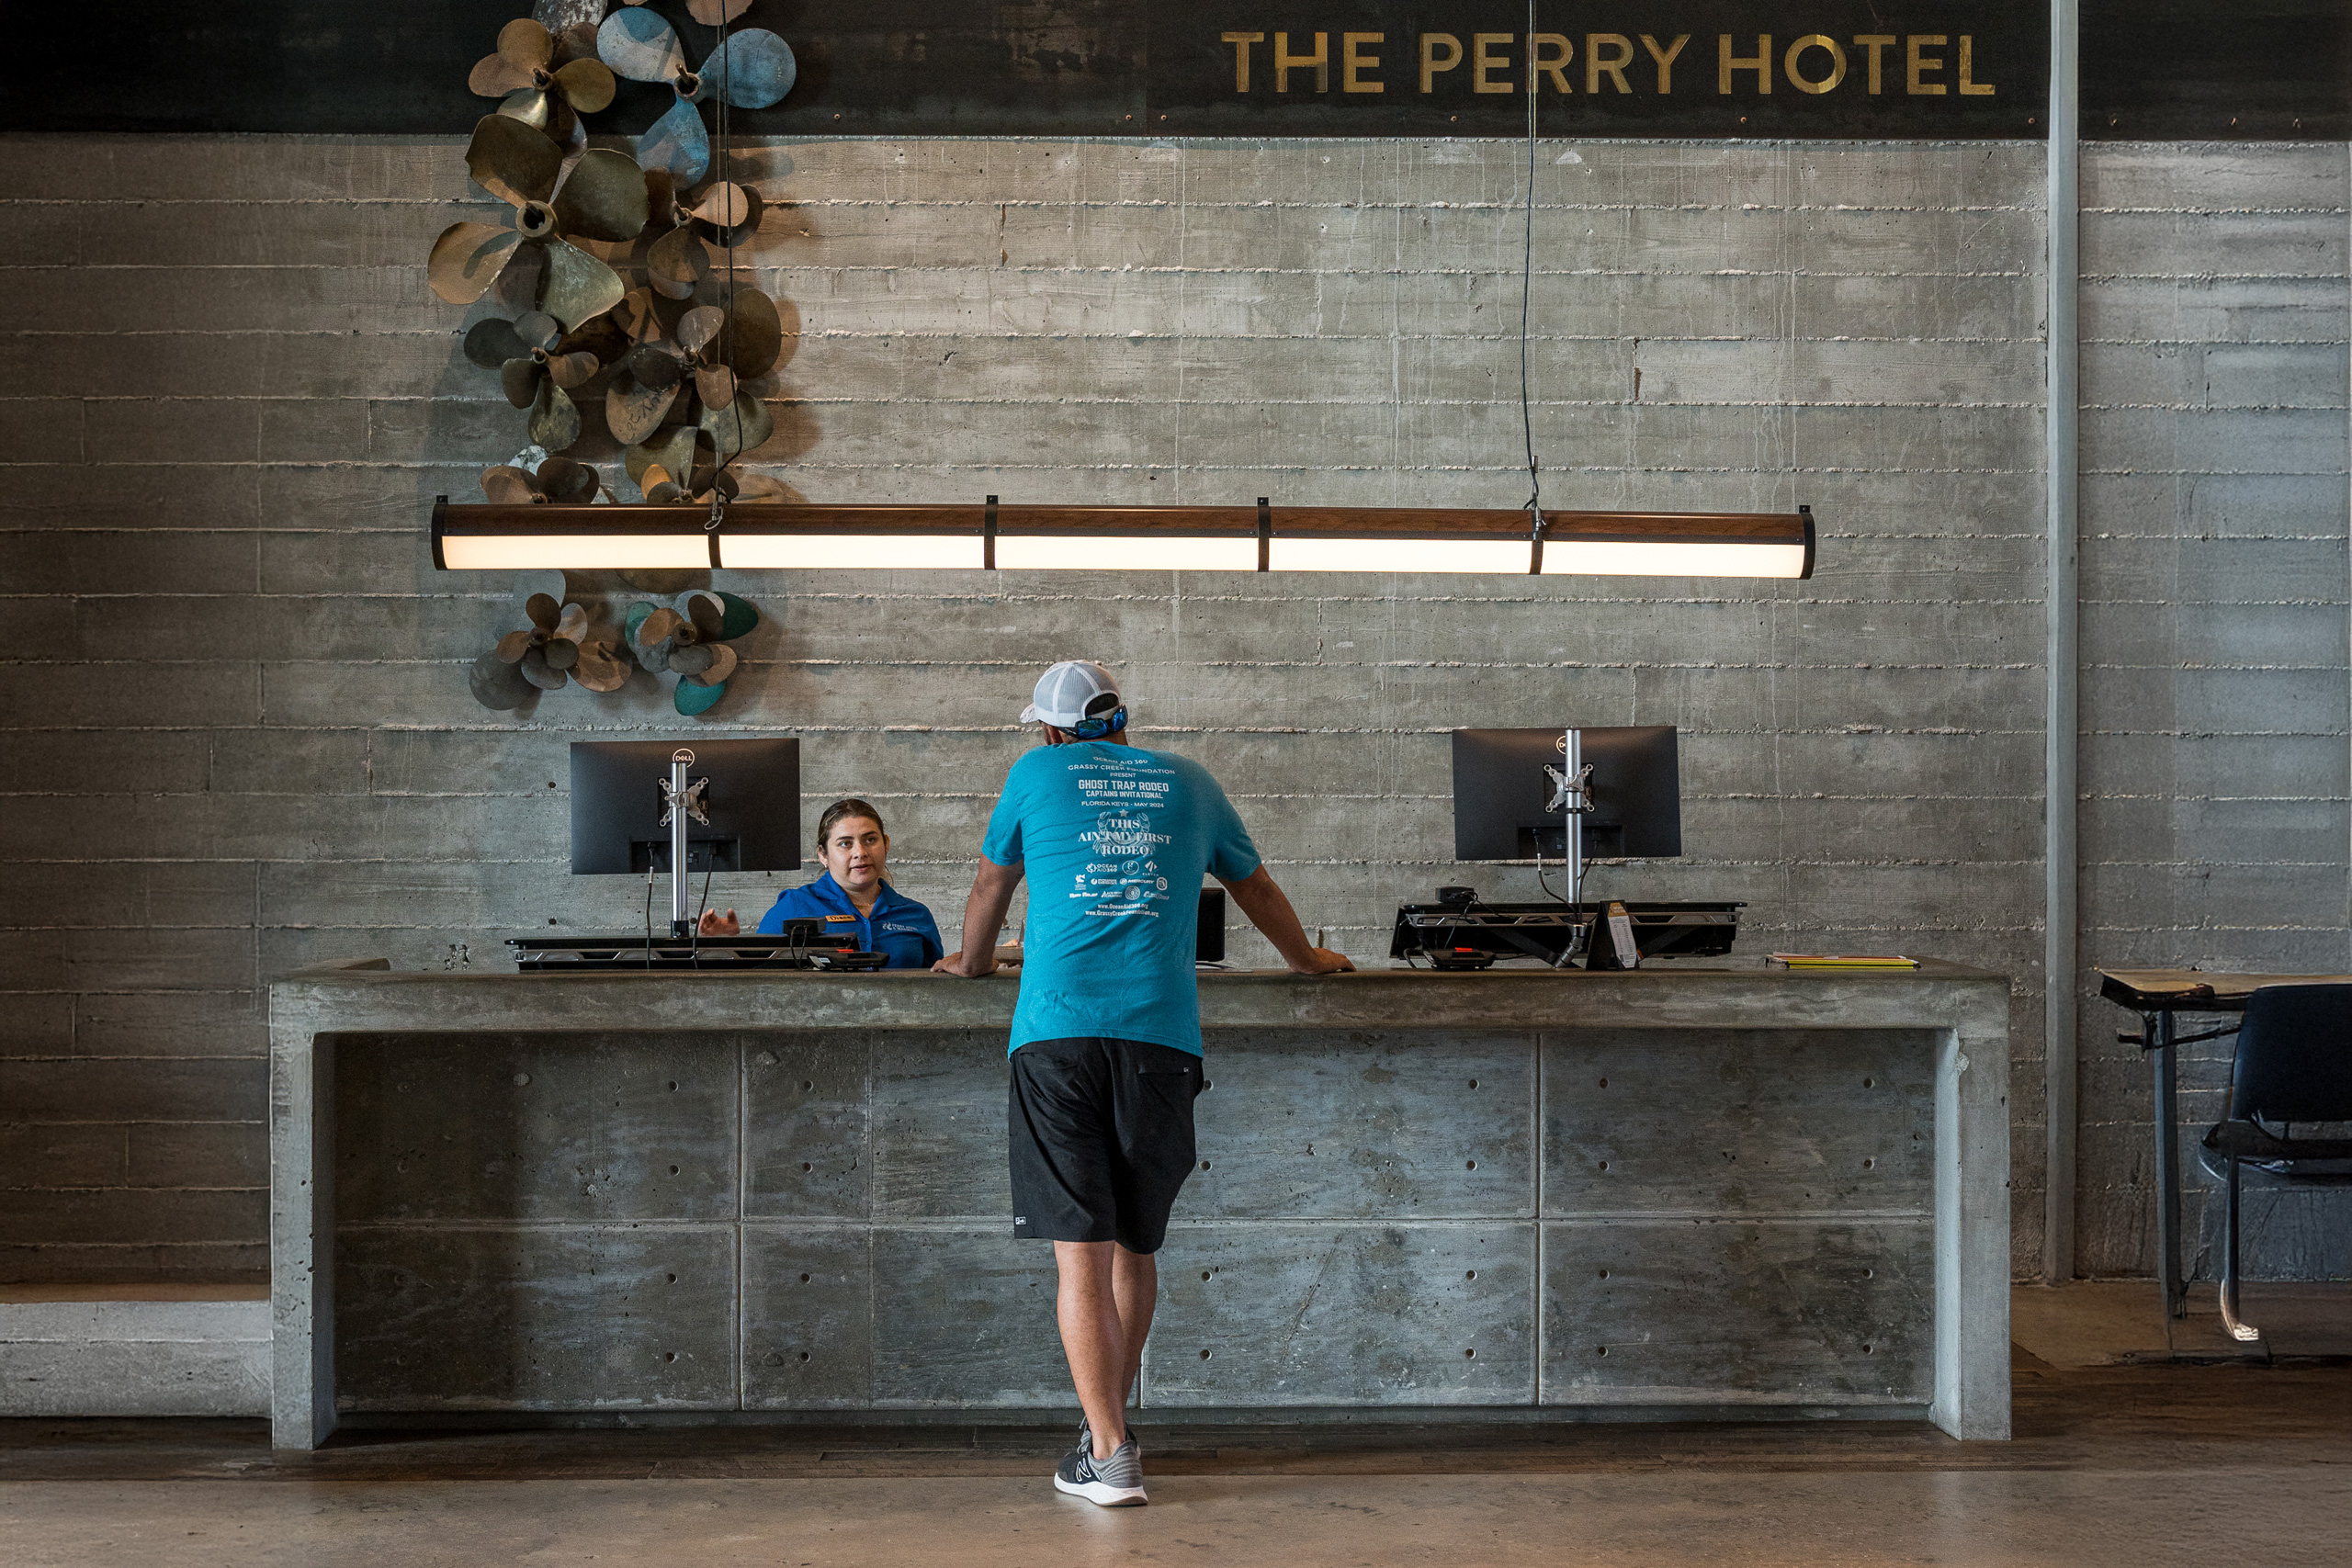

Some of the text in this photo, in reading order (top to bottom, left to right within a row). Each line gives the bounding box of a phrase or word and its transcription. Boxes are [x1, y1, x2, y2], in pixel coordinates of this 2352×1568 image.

[1221, 31, 1996, 96] THE PERRY HOTEL
[1126, 766, 1175, 774] FOUNDATION
[1079, 779, 1170, 793] GHOST TRAP RODEO
[1119, 791, 1163, 799] INVITATIONAL
[1108, 818, 1140, 829] THIS
[1078, 831, 1171, 844] AIN'T MY FIRST
[1102, 845, 1149, 855] RODEO
